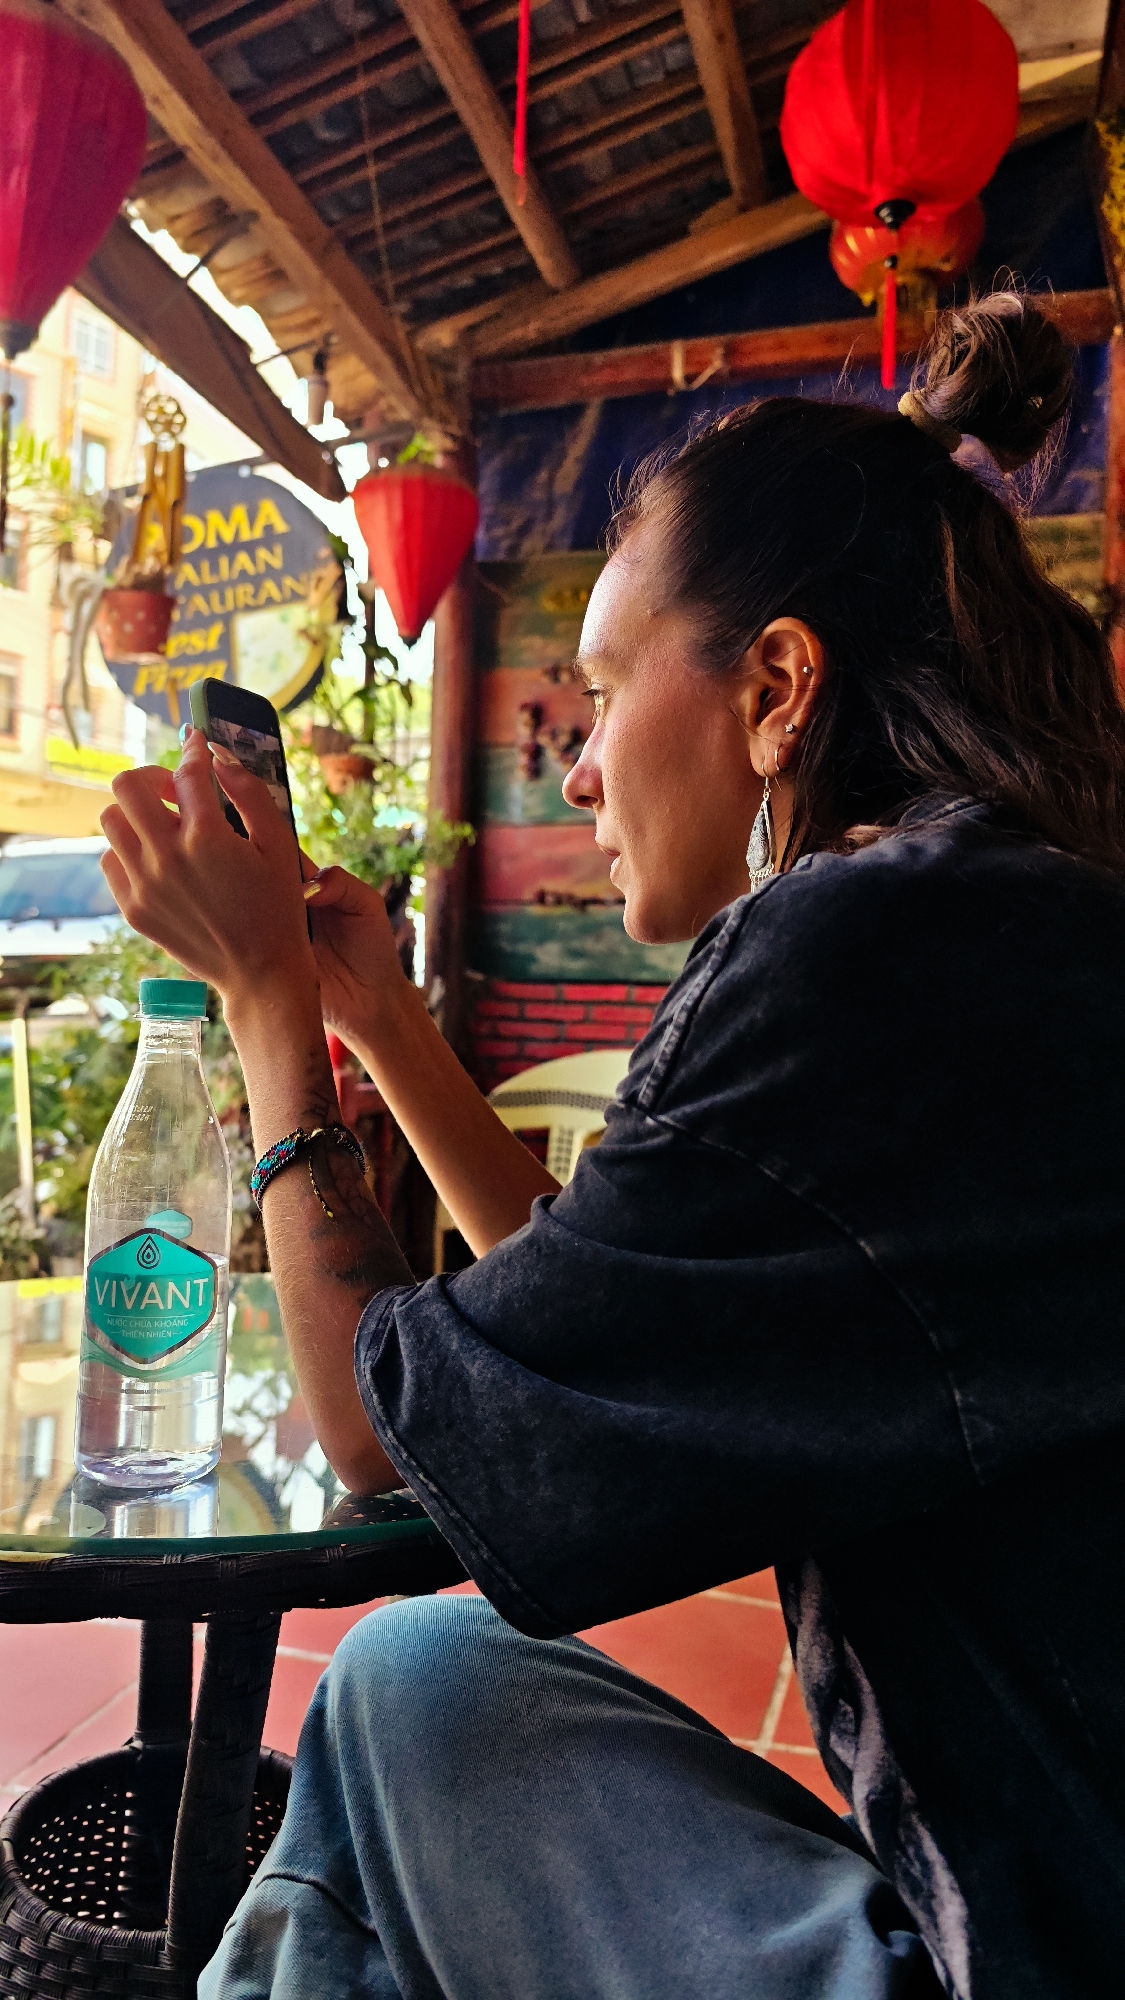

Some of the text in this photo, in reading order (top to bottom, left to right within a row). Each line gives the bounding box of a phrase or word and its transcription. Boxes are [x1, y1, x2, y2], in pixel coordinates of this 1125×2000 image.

[174, 541, 284, 590] ALIAN
[164, 620, 224, 659] est
[94, 1276, 209, 1310] VIVANT
